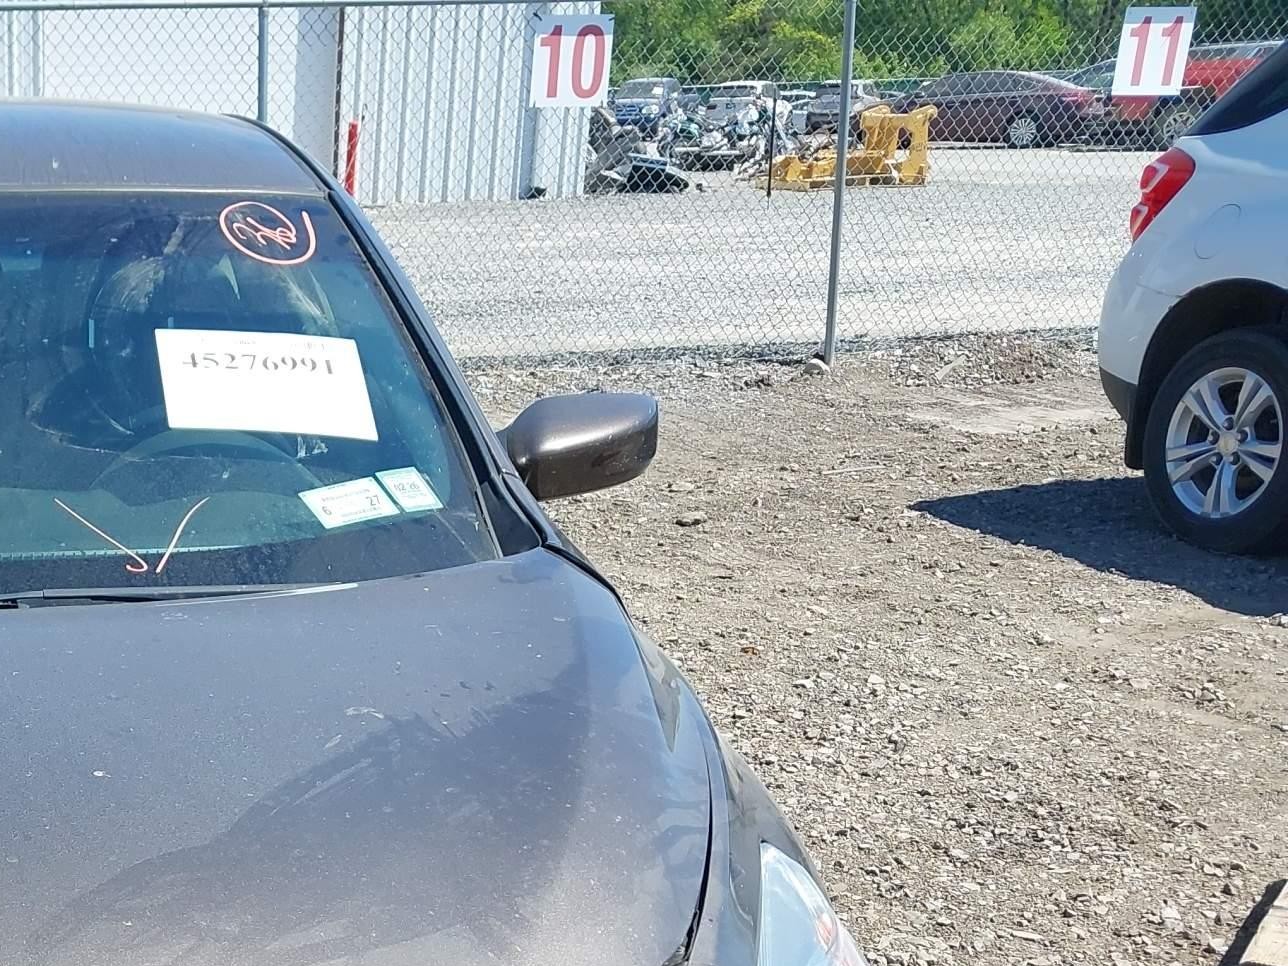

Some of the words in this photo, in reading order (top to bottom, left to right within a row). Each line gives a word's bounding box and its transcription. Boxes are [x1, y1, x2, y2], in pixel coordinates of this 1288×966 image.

[539, 23, 606, 98] 10
[1130, 15, 1184, 87] 11
[182, 351, 335, 375] 45276991
[365, 494, 382, 507] 27
